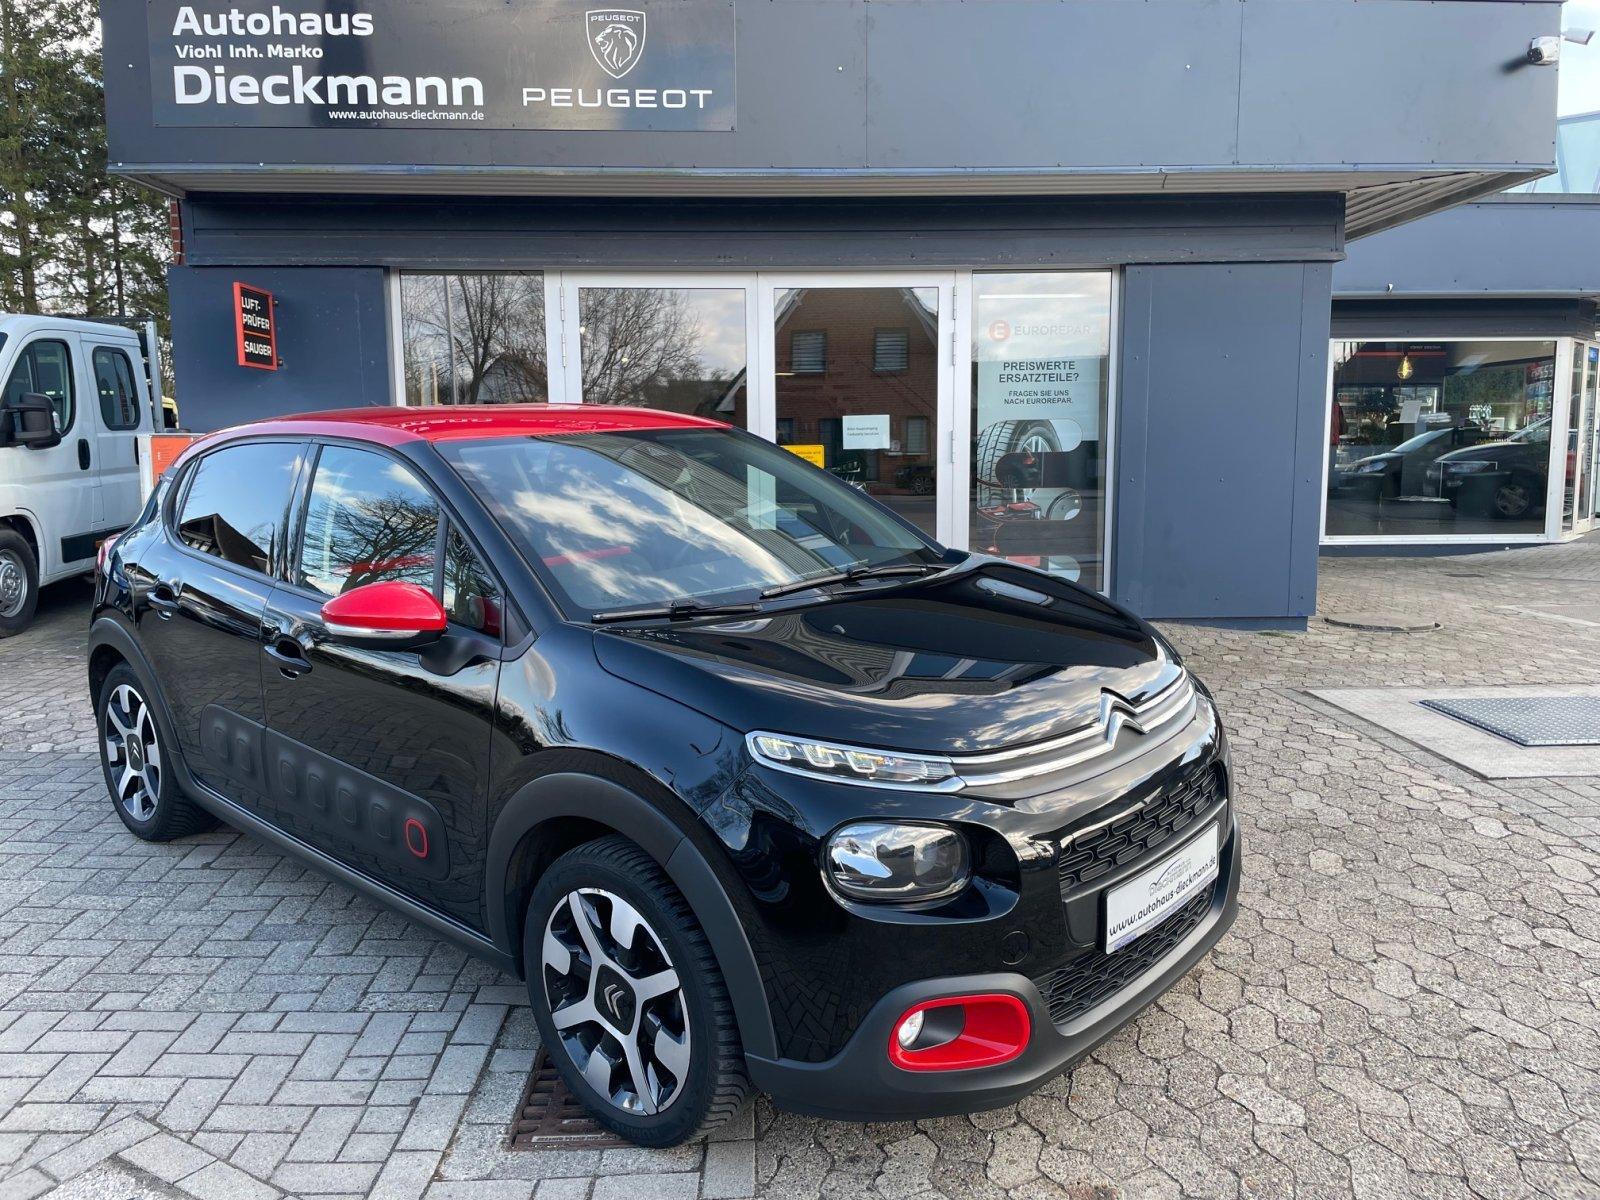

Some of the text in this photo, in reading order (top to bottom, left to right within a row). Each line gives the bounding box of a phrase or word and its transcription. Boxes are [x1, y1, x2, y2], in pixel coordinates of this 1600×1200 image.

[172, 6, 374, 36] Autohaus
[590, 14, 641, 22] PEUGEOT
[174, 44, 324, 58] Viohl Inh. Marko
[173, 65, 484, 106] Dieckmann
[522, 87, 713, 108] PEUGEOT
[328, 109, 484, 121] www.autohaus-dieckmann.de
[241, 296, 261, 311] LUFT-
[242, 313, 270, 330] PRÜFER
[1014, 325, 1091, 336] EUROREPAR
[244, 341, 272, 357] SAUGER
[1003, 361, 1075, 371] PREISWERTE
[999, 372, 1079, 383] ERSATZTEILE?
[1109, 855, 1216, 937] www.autohaus-dieckmann.de
